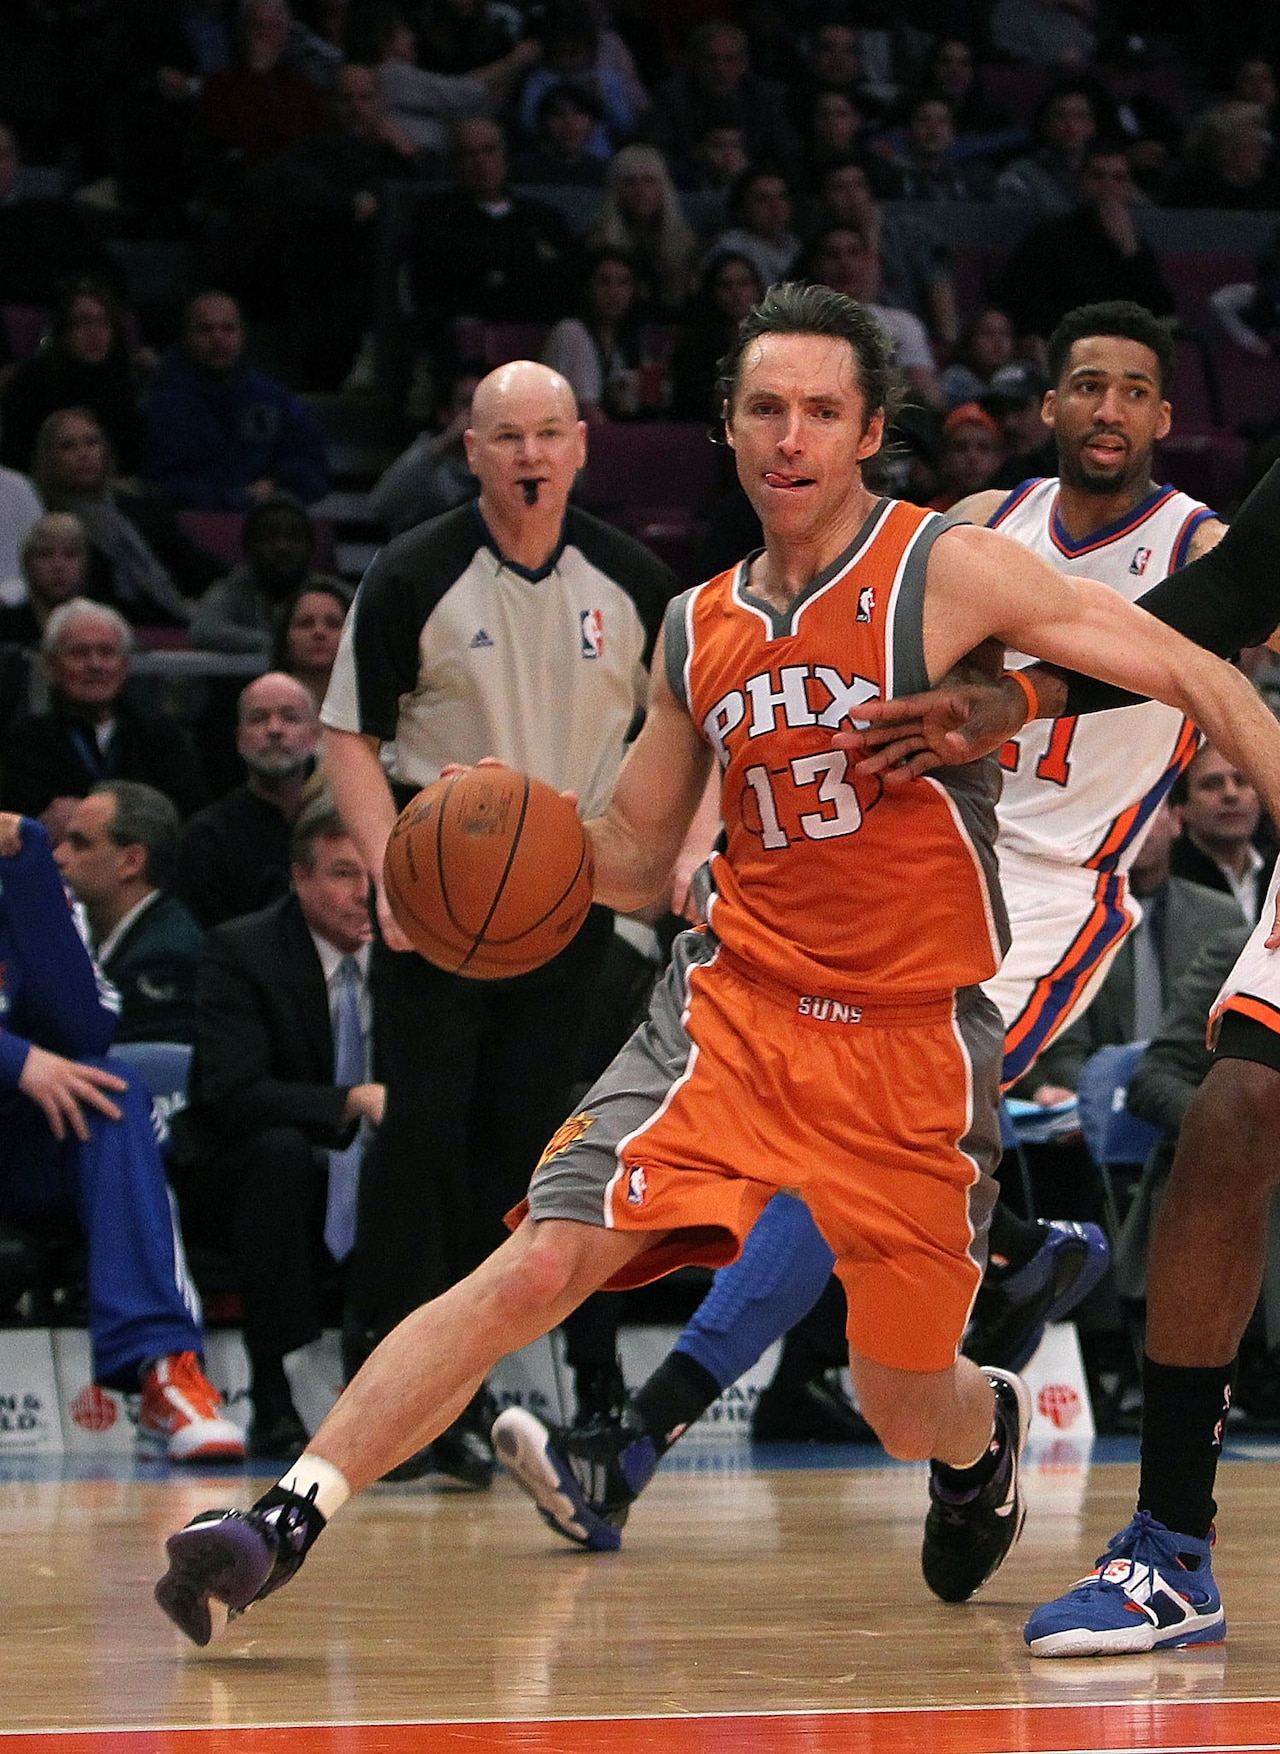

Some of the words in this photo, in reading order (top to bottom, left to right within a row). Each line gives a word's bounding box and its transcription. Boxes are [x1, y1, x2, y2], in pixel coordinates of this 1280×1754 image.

[703, 664, 881, 768] PHX
[998, 715, 1078, 787] 1
[744, 750, 863, 850] 13
[798, 995, 864, 1024] SUNS
